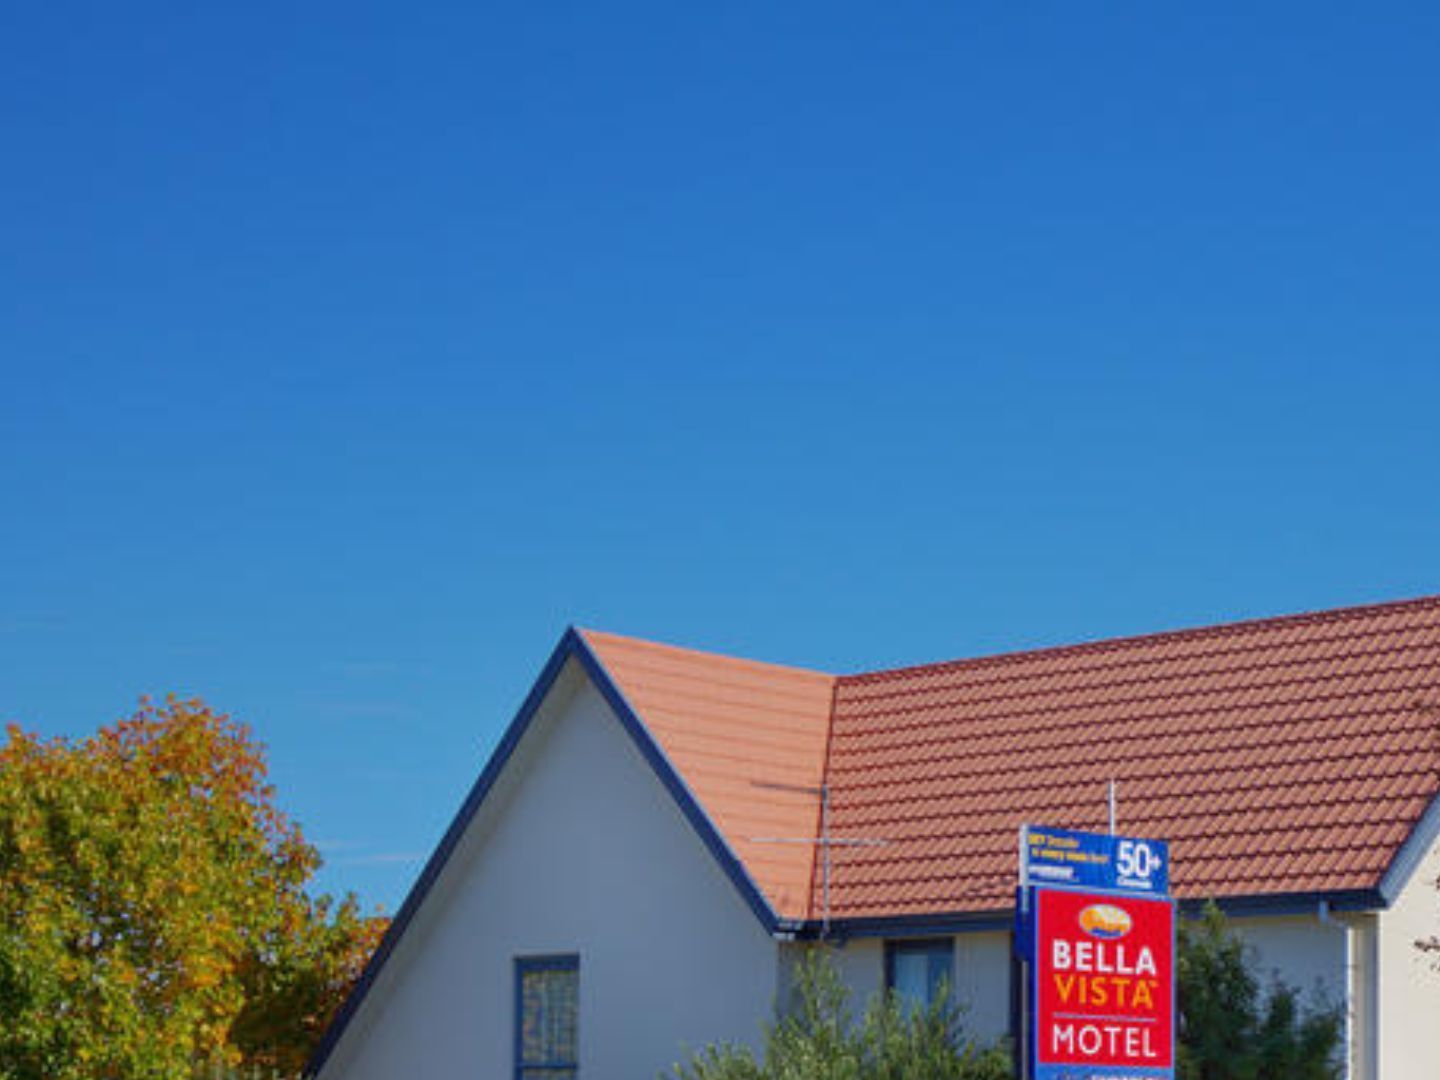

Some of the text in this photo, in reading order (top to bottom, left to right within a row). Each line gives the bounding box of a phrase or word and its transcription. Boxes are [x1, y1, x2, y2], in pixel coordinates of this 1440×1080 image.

[1117, 840, 1162, 877] 50+
[1053, 939, 1156, 975] BELLA
[1054, 974, 1154, 1010] VISTA
[1053, 1024, 1157, 1058] MOTEL
